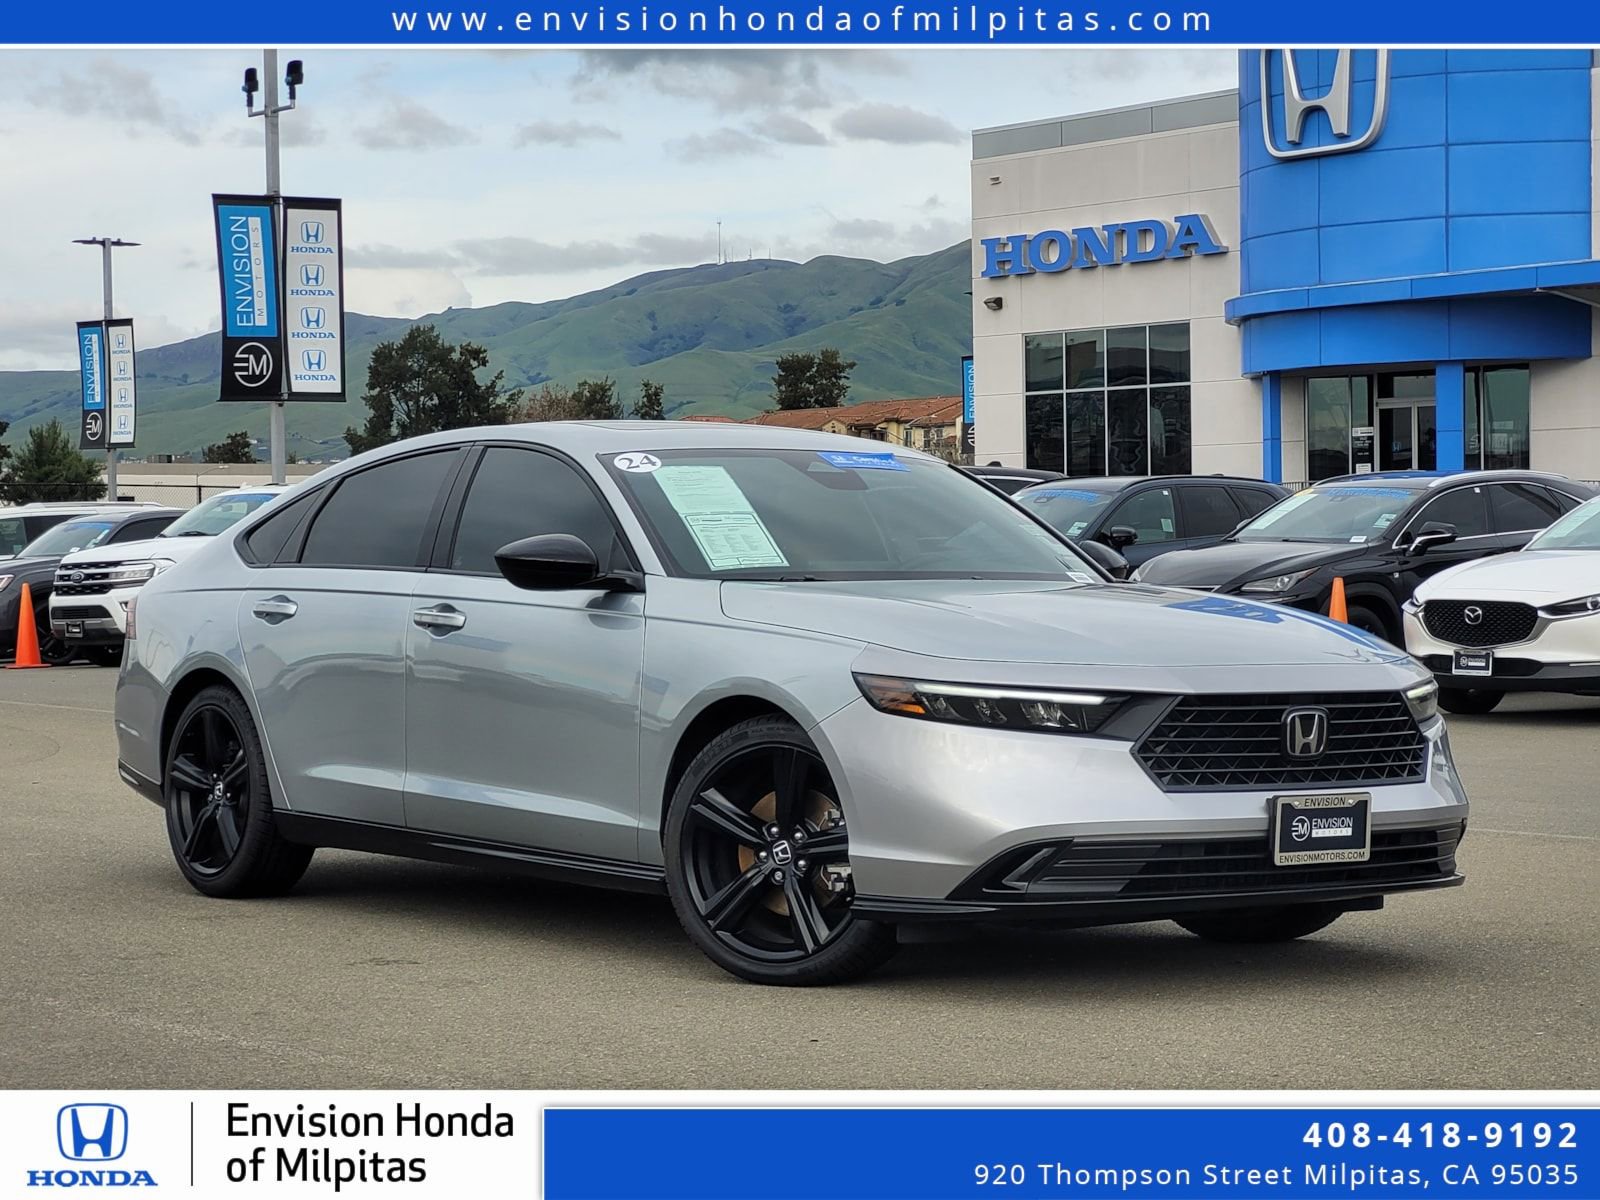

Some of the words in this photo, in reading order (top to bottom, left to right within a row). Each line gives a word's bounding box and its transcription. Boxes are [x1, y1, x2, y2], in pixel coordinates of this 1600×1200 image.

[290, 246, 334, 254] HONDA
[980, 213, 1229, 279] HONDA
[229, 215, 254, 327] ENVISION
[251, 226, 265, 318] MOTORS
[290, 288, 335, 296] HONDA
[291, 331, 336, 339] HONDA
[84, 334, 96, 403] ENVISION
[294, 374, 337, 382] HONDA
[618, 455, 657, 470] 24
[1304, 796, 1346, 808] ENVISION
[1312, 817, 1353, 829] ENVISION
[1279, 851, 1366, 864] ENVISIONMOTORS.COM
